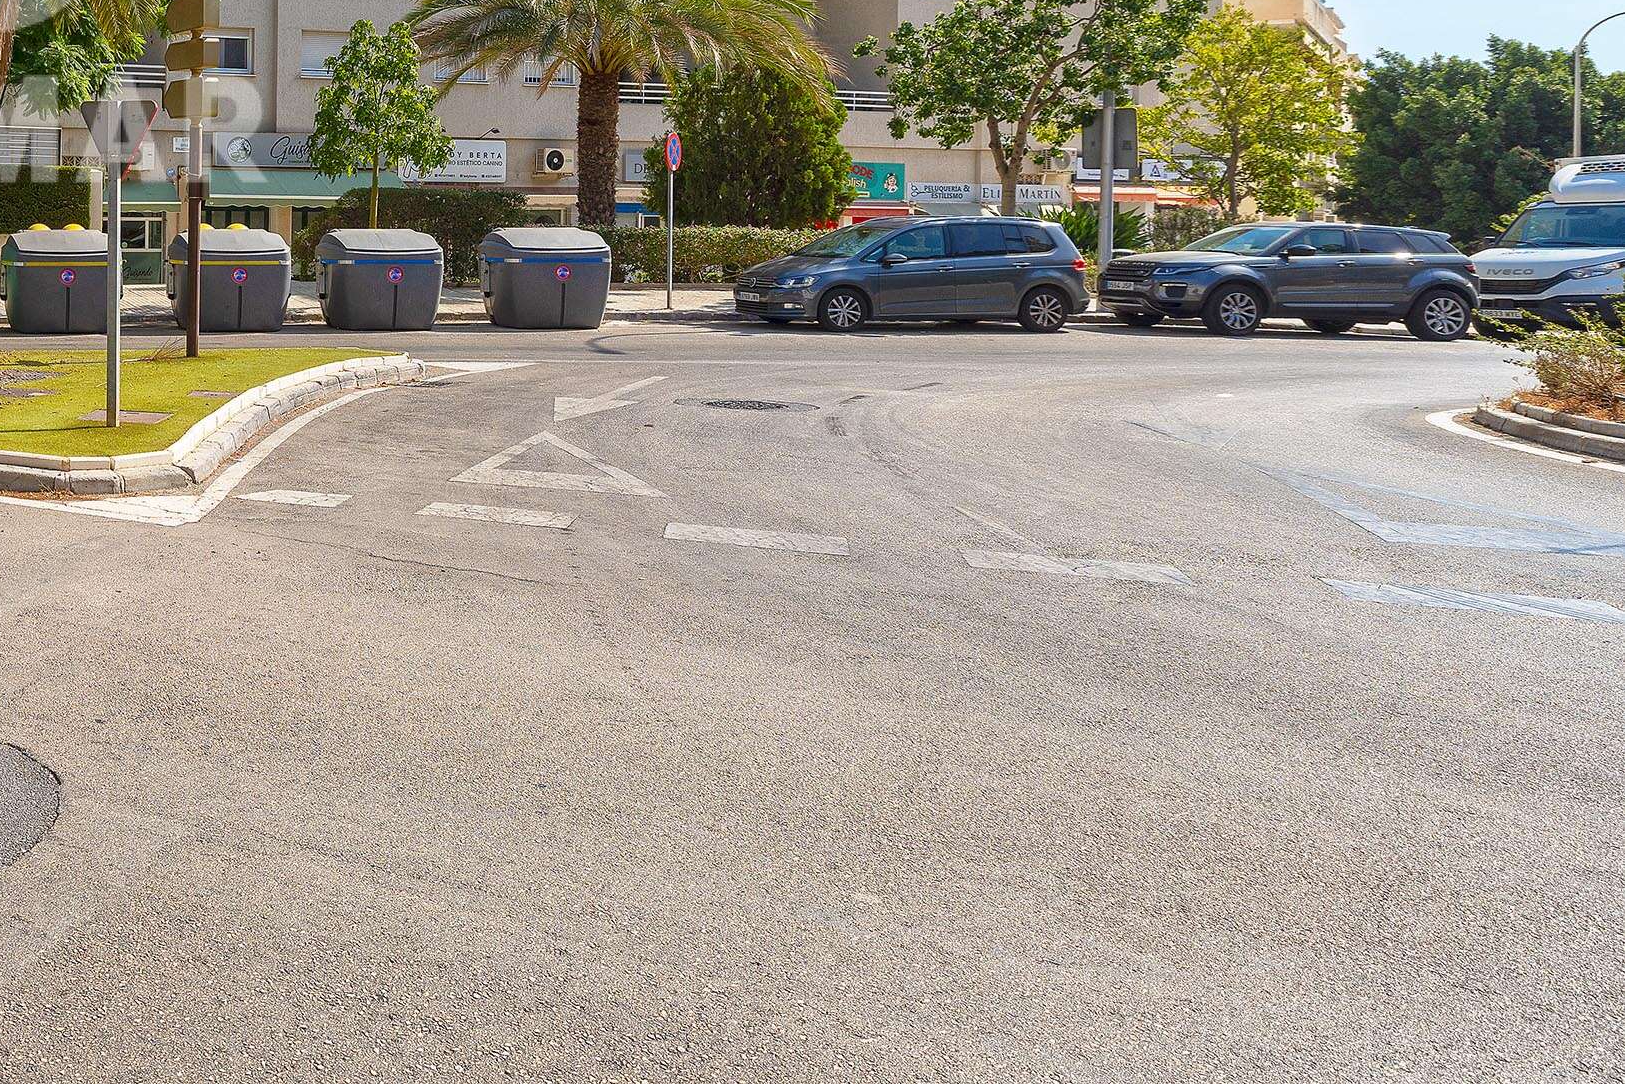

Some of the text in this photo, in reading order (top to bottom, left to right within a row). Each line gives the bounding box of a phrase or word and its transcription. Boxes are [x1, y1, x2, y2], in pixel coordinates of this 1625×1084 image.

[963, 184, 971, 193] &
[931, 192, 964, 200] ESTILISMO
[1486, 268, 1535, 276] IVECO
